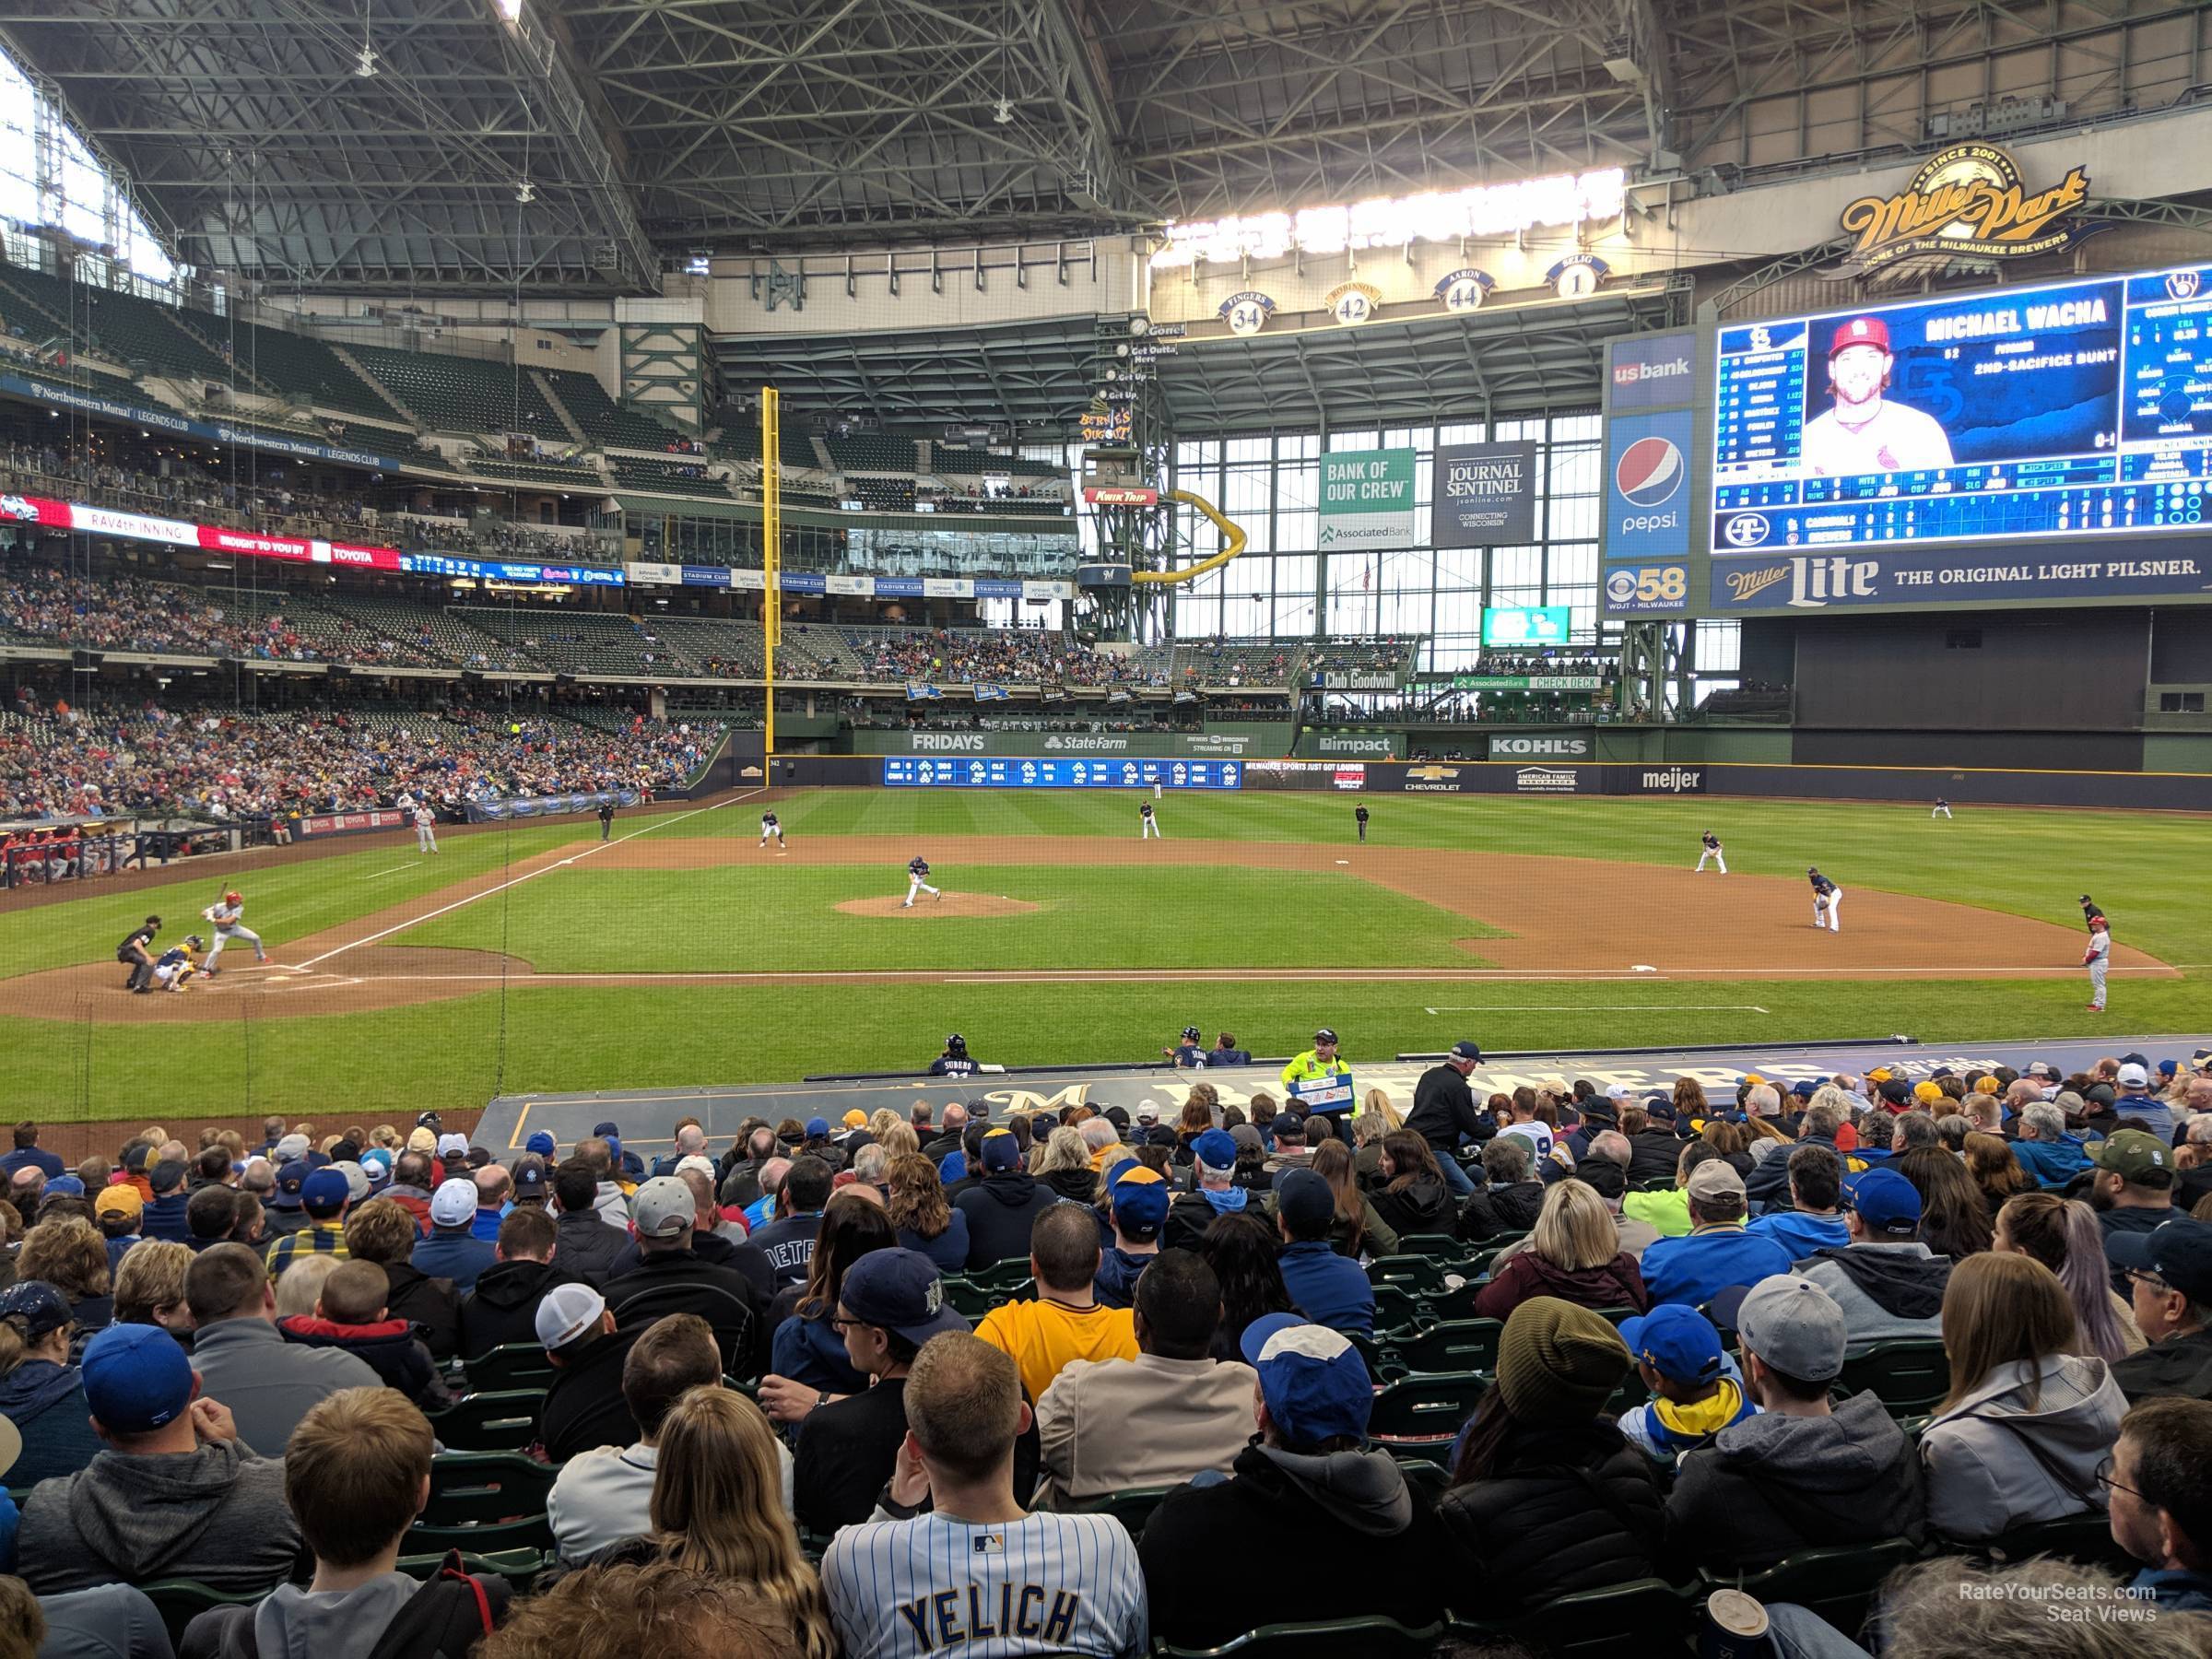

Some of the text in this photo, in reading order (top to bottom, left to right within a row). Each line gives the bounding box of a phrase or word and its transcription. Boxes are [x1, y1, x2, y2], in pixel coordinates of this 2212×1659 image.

[1924, 147, 2001, 175] SINCE 2001
[1842, 169, 2087, 253] Miller Park
[1864, 232, 2068, 268] HOME OF THE MILWAUKEE BREWERS
[1562, 254, 1593, 267] SELIG
[1450, 270, 1481, 281] AARON
[1571, 274, 1582, 295] 1
[1228, 291, 1267, 307] FINGERS
[1331, 285, 1377, 300] ROBINSON
[1450, 288, 1477, 306] 44
[1339, 300, 1365, 319] 42
[1234, 309, 1259, 329] 34
[1925, 299, 2107, 342] MICHAEL WACHA
[1148, 324, 1185, 336] Gone!
[1131, 347, 1147, 356] Get
[1135, 355, 1156, 363] Here
[2076, 347, 2118, 365] BUNT
[1119, 373, 1134, 382] Get
[1109, 391, 1124, 400] Get
[43, 387, 189, 431] Northwestern Mutual LEGENDS CLUB
[230, 431, 380, 466] Northwestern Mutual LEGENDS CLUB
[1328, 461, 1389, 481] BANK OF
[1447, 464, 1524, 484] JOURNAL
[1327, 482, 1356, 501] OUR
[1446, 479, 1524, 497] SENTINEL
[1859, 480, 1981, 498] AVG SLG
[1456, 496, 1513, 506] jsonline.com
[2059, 501, 2069, 514] 4
[2082, 500, 2091, 513] 7
[2124, 497, 2135, 511] 4
[2155, 499, 2165, 511] S
[1458, 512, 1509, 522] CONNECTING
[1462, 519, 1504, 528] WISCONSIN
[1622, 511, 1677, 535] pepsi
[138, 518, 182, 539] INNING
[333, 547, 372, 563] TOYOTA
[1895, 559, 2202, 586] THE ORIGINAL LIGHT PILSNER.
[1636, 567, 1687, 602] 58
[1725, 557, 1878, 607] Miller Lite
[1608, 600, 1685, 610] WDJT MILWAUKEE
[1325, 672, 1395, 688] Club Goodwill
[1536, 677, 1595, 688] CHECK DECK
[912, 735, 985, 750] FRIDAYS
[1333, 736, 1391, 754] impact
[1405, 782, 1461, 792] CHEVROLET
[1642, 767, 1700, 793] meijer
[345, 816, 365, 824] TOYOTA
[381, 813, 400, 821] TOYOTA
[944, 1060, 972, 1071] SUBERO
[898, 1582, 1081, 1653] YELICH
